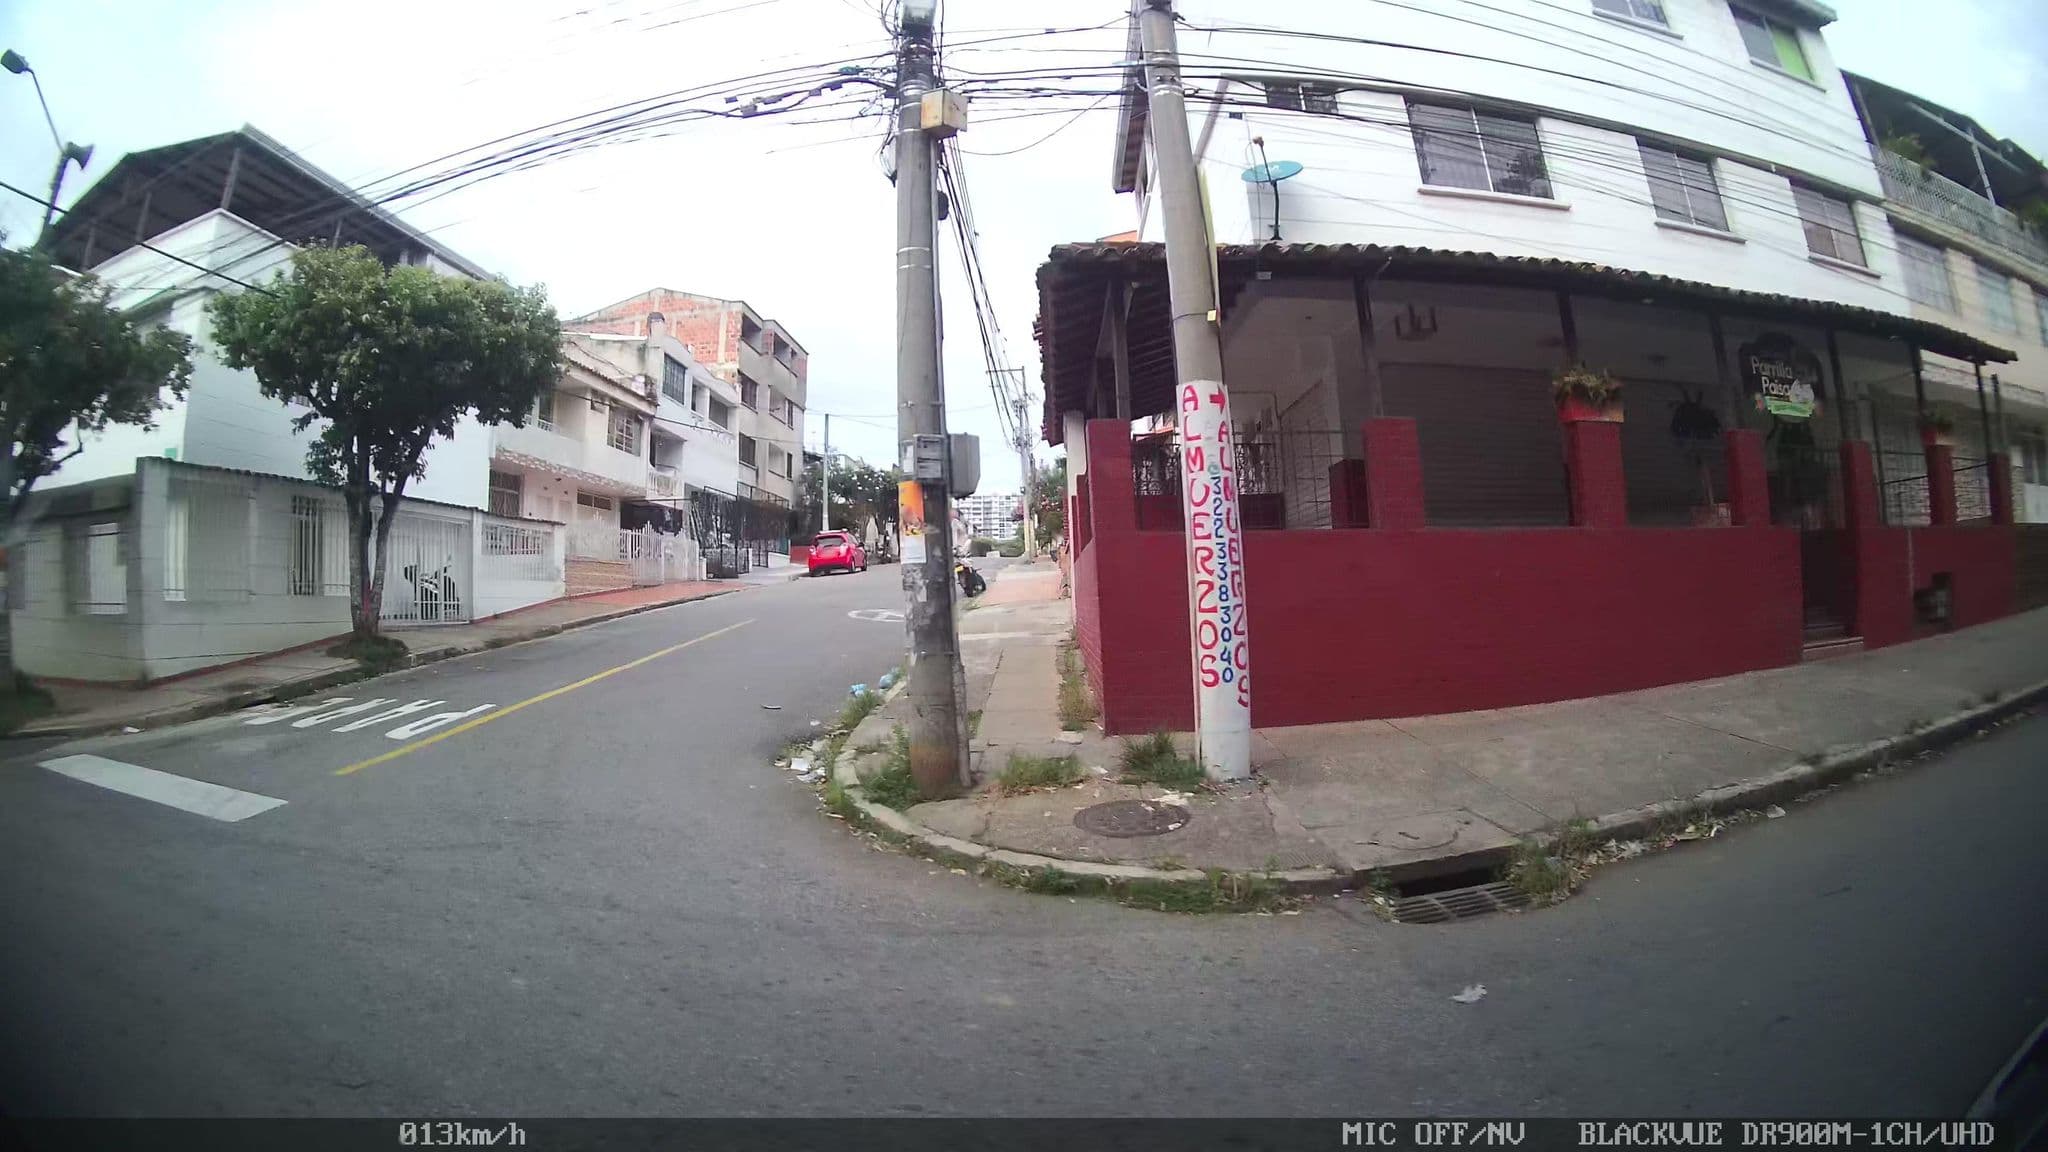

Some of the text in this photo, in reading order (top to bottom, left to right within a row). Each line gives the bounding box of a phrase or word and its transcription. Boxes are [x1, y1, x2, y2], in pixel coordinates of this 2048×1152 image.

[1750, 355, 1793, 379] Parrilla
[1761, 376, 1791, 396] Paisa
[1183, 384, 1220, 688] ALMUERZOS
[1210, 476, 1234, 684] 3223383040
